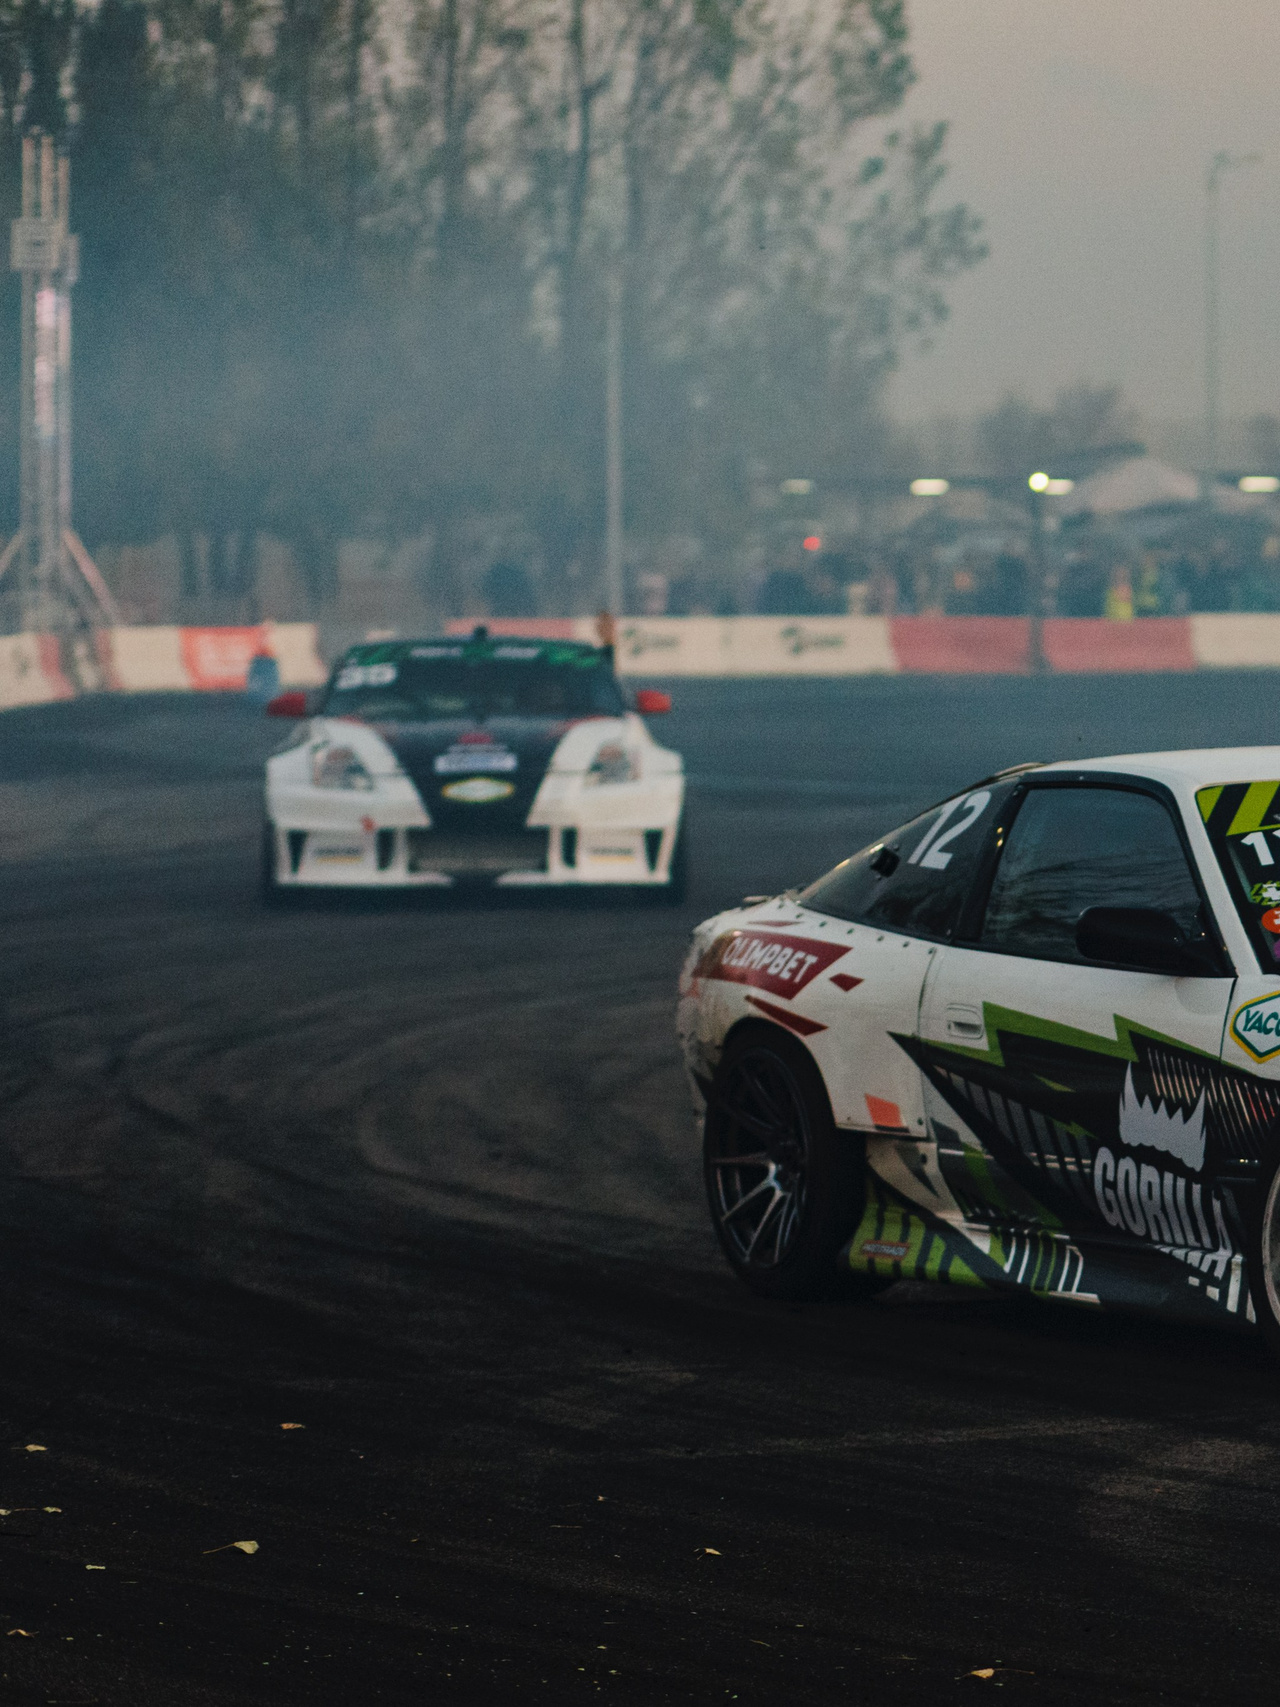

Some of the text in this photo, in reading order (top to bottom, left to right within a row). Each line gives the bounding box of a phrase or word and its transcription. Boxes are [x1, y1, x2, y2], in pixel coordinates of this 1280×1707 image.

[906, 790, 992, 870] 12
[721, 937, 818, 983] OLIMPBET
[1094, 1146, 1233, 1258] GORILLA
